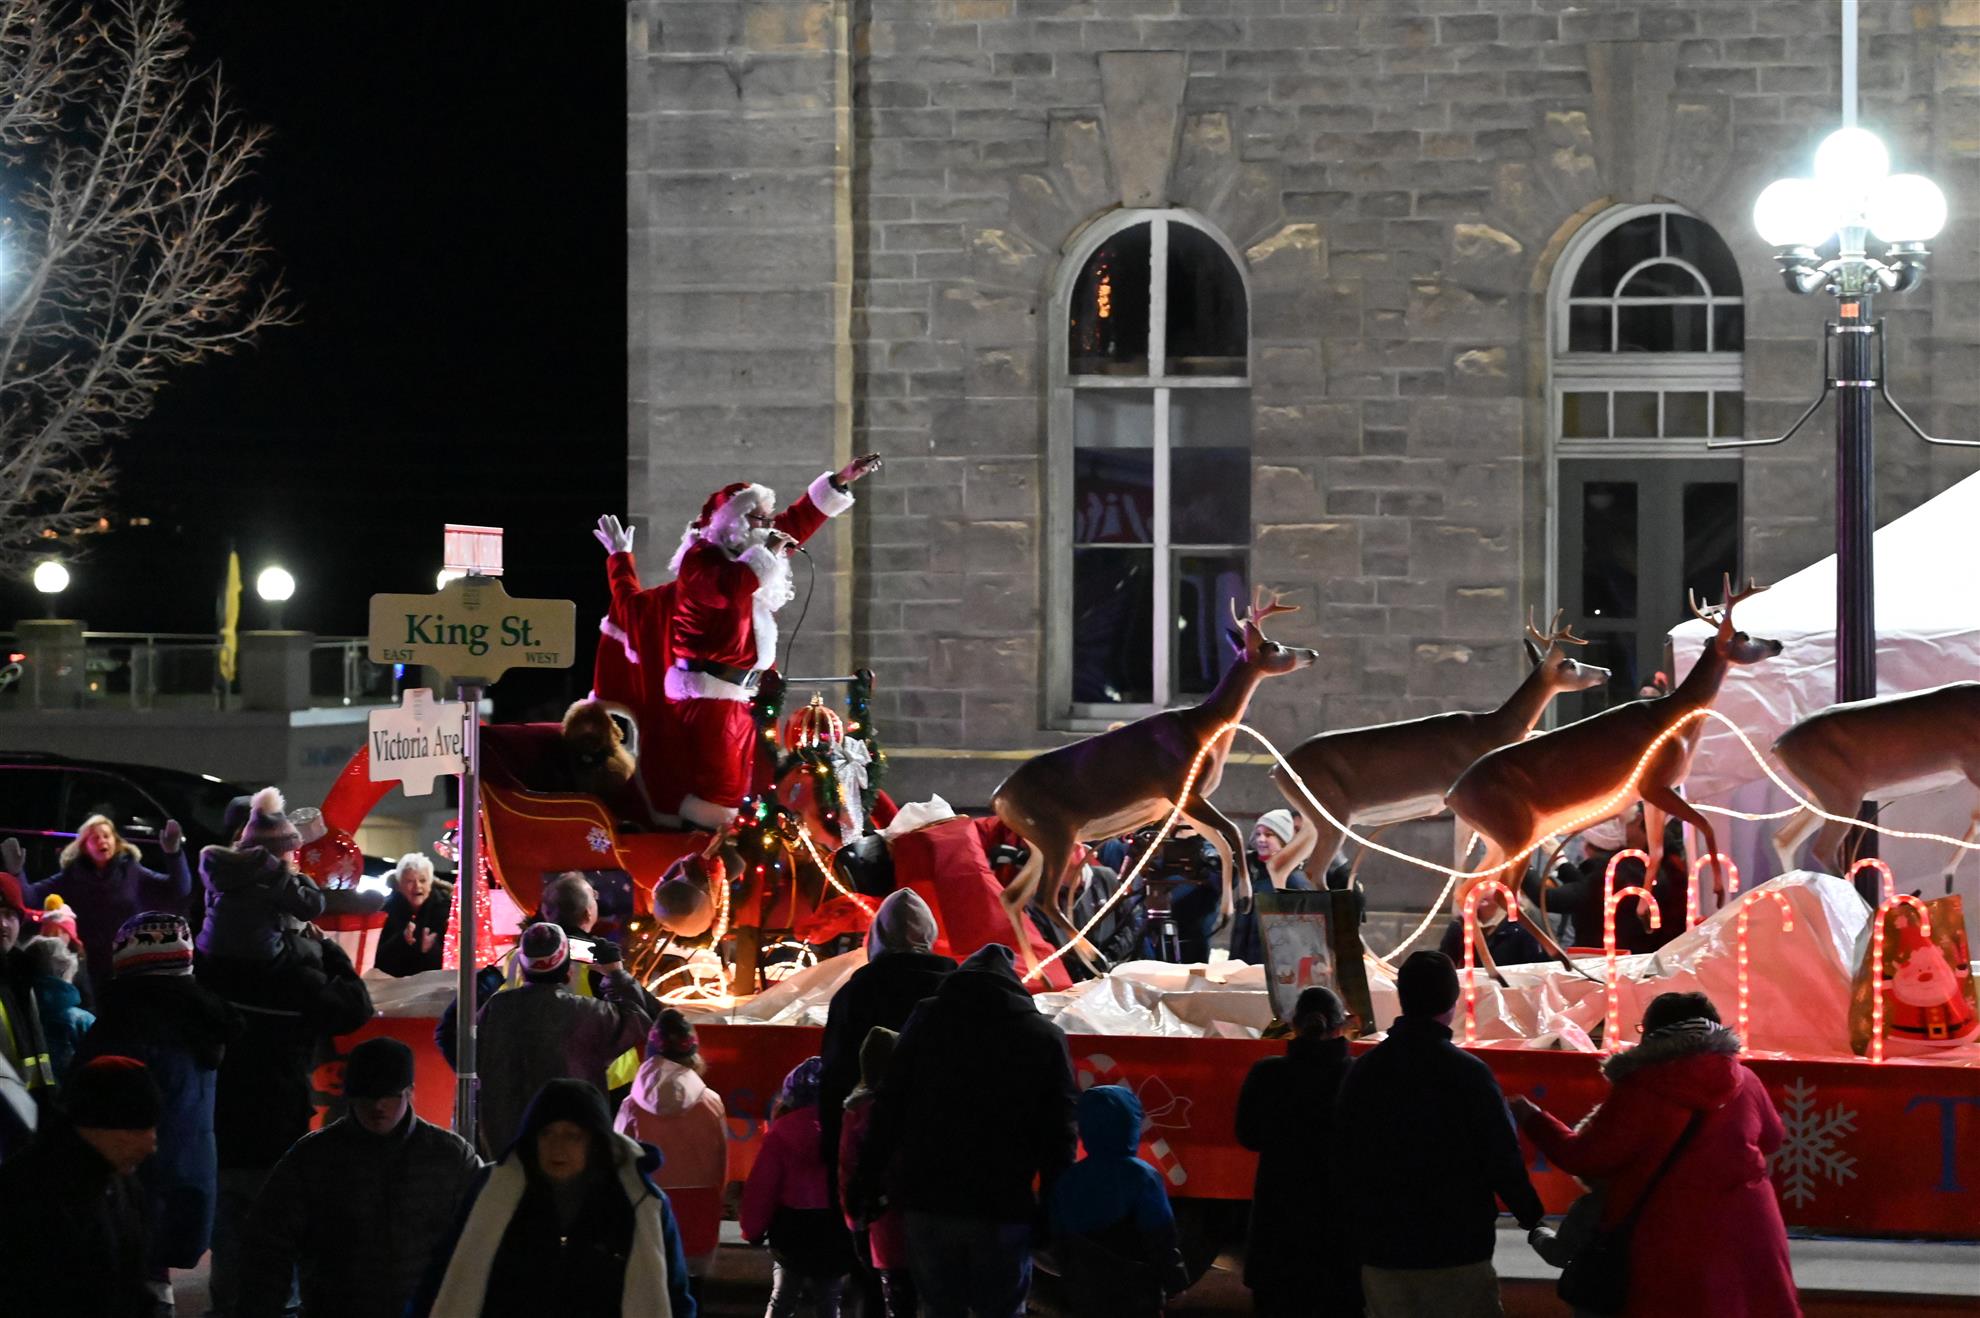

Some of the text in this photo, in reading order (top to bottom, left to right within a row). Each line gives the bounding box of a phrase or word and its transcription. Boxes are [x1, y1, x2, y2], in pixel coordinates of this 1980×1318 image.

[405, 614, 541, 656] King St.
[383, 649, 415, 661] EAST
[525, 652, 560, 664] WEST
[372, 727, 429, 762] Victoria
